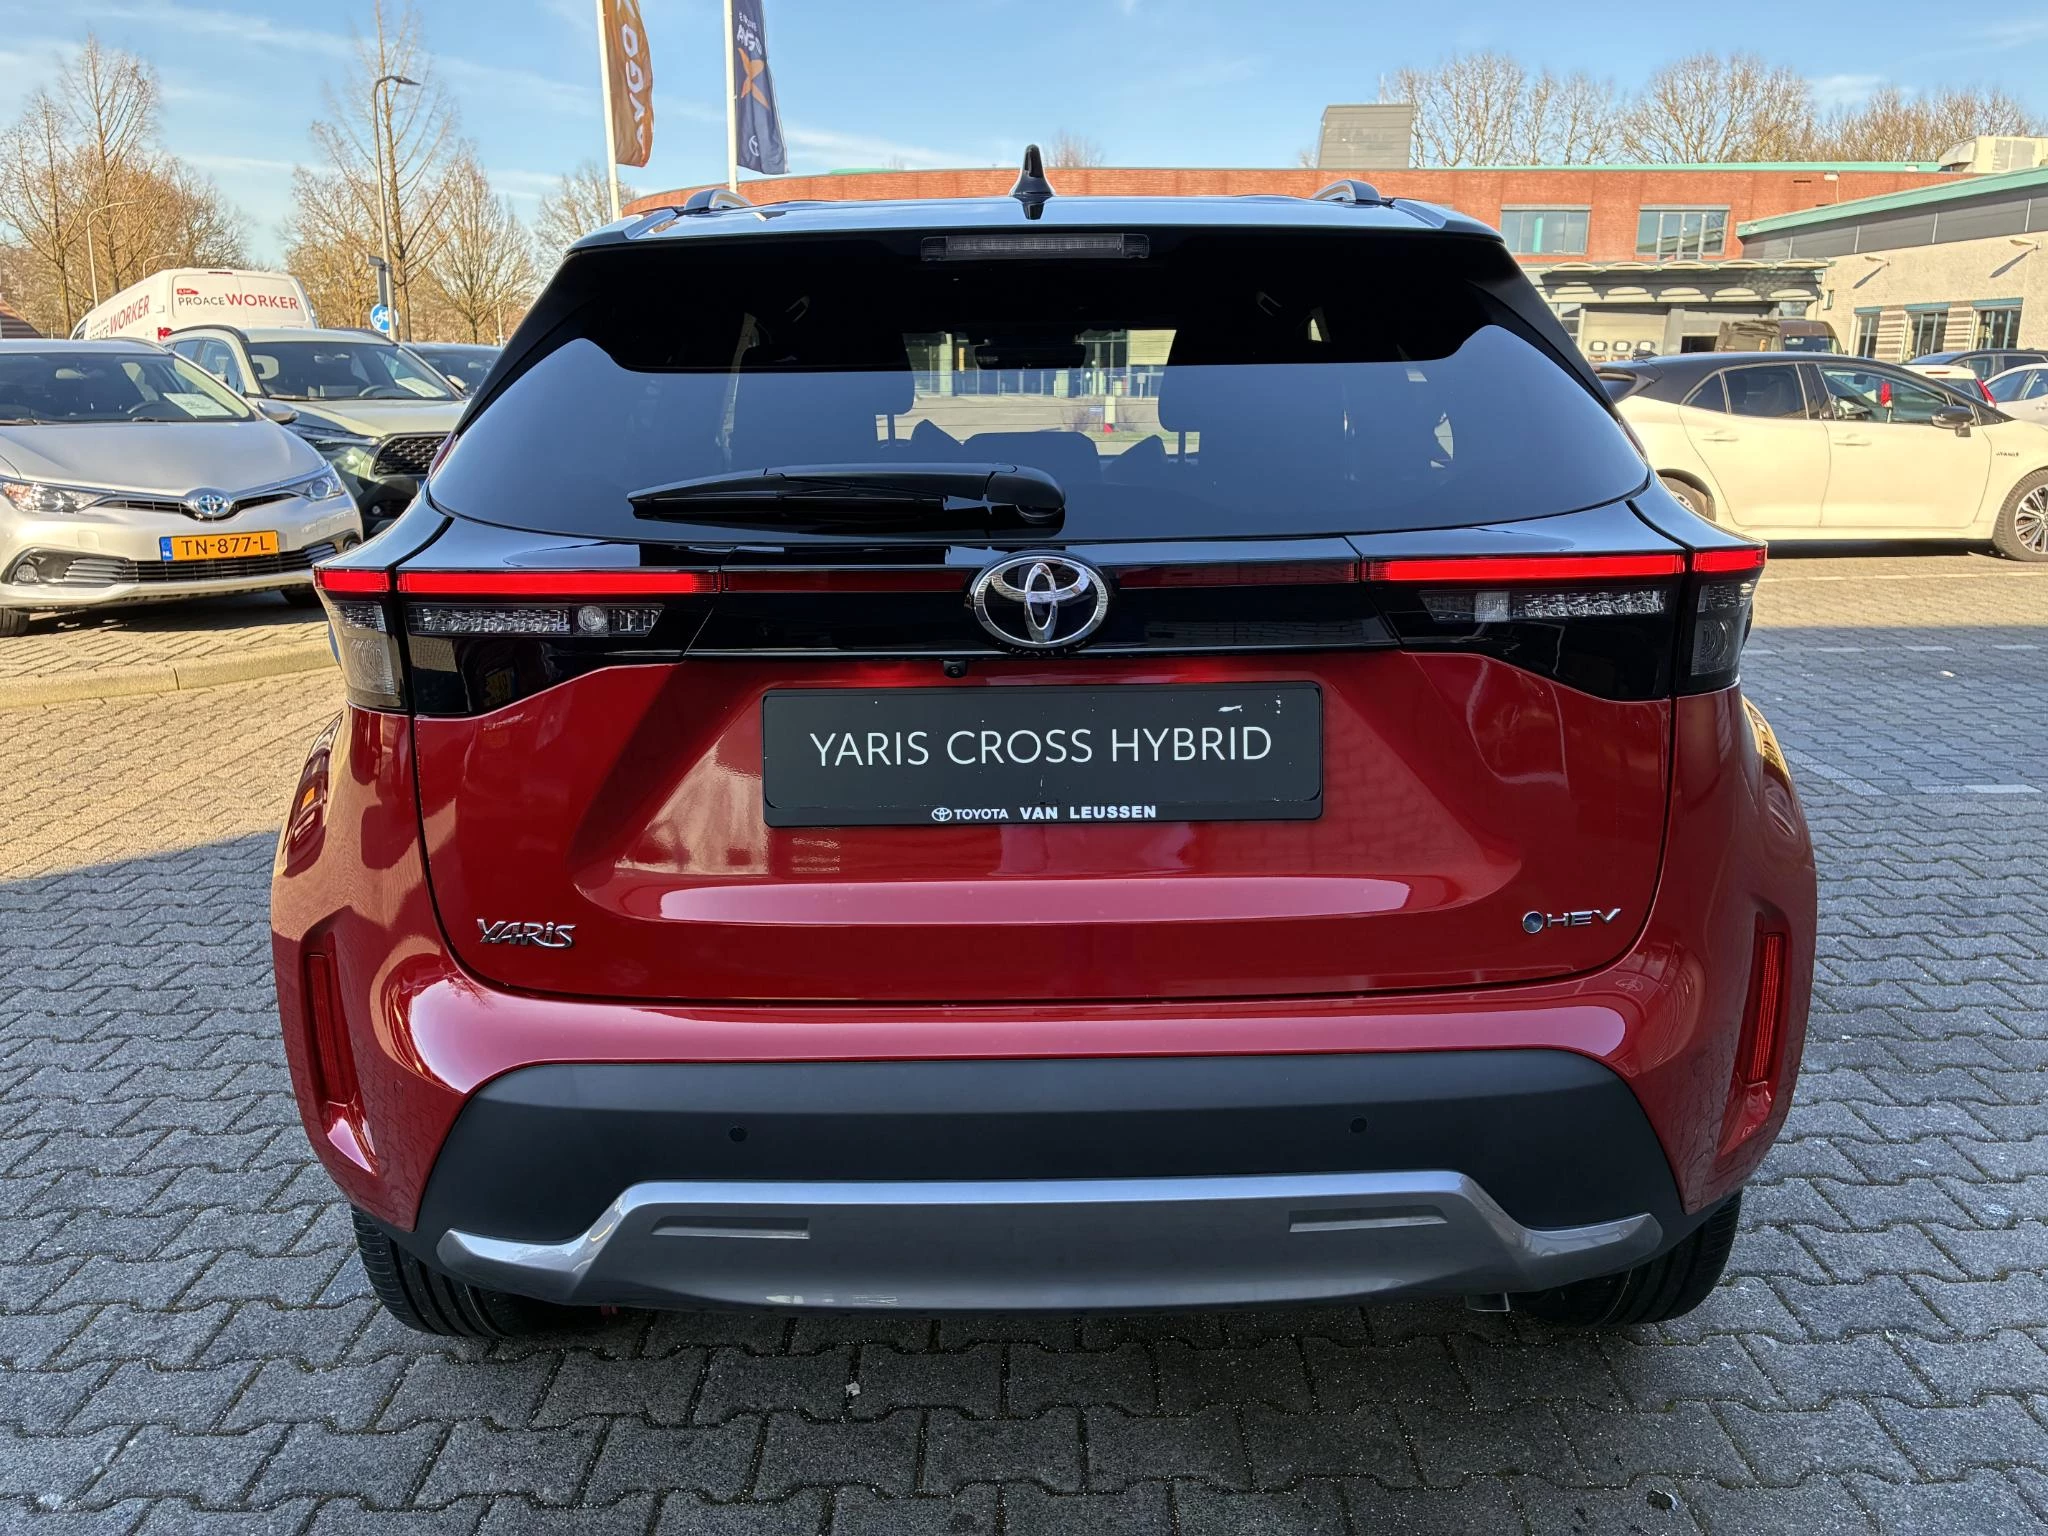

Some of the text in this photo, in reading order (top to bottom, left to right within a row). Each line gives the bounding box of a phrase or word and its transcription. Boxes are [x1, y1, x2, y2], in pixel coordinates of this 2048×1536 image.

[178, 293, 299, 310] PROACE WORKER
[110, 294, 150, 334] WORKER
[181, 535, 271, 556] TN-877-L
[809, 726, 1272, 767] YARIS CROSS HYBRID
[954, 805, 1157, 820] TOYOTA VAN LEUSSEN
[1546, 907, 1622, 928] HEV
